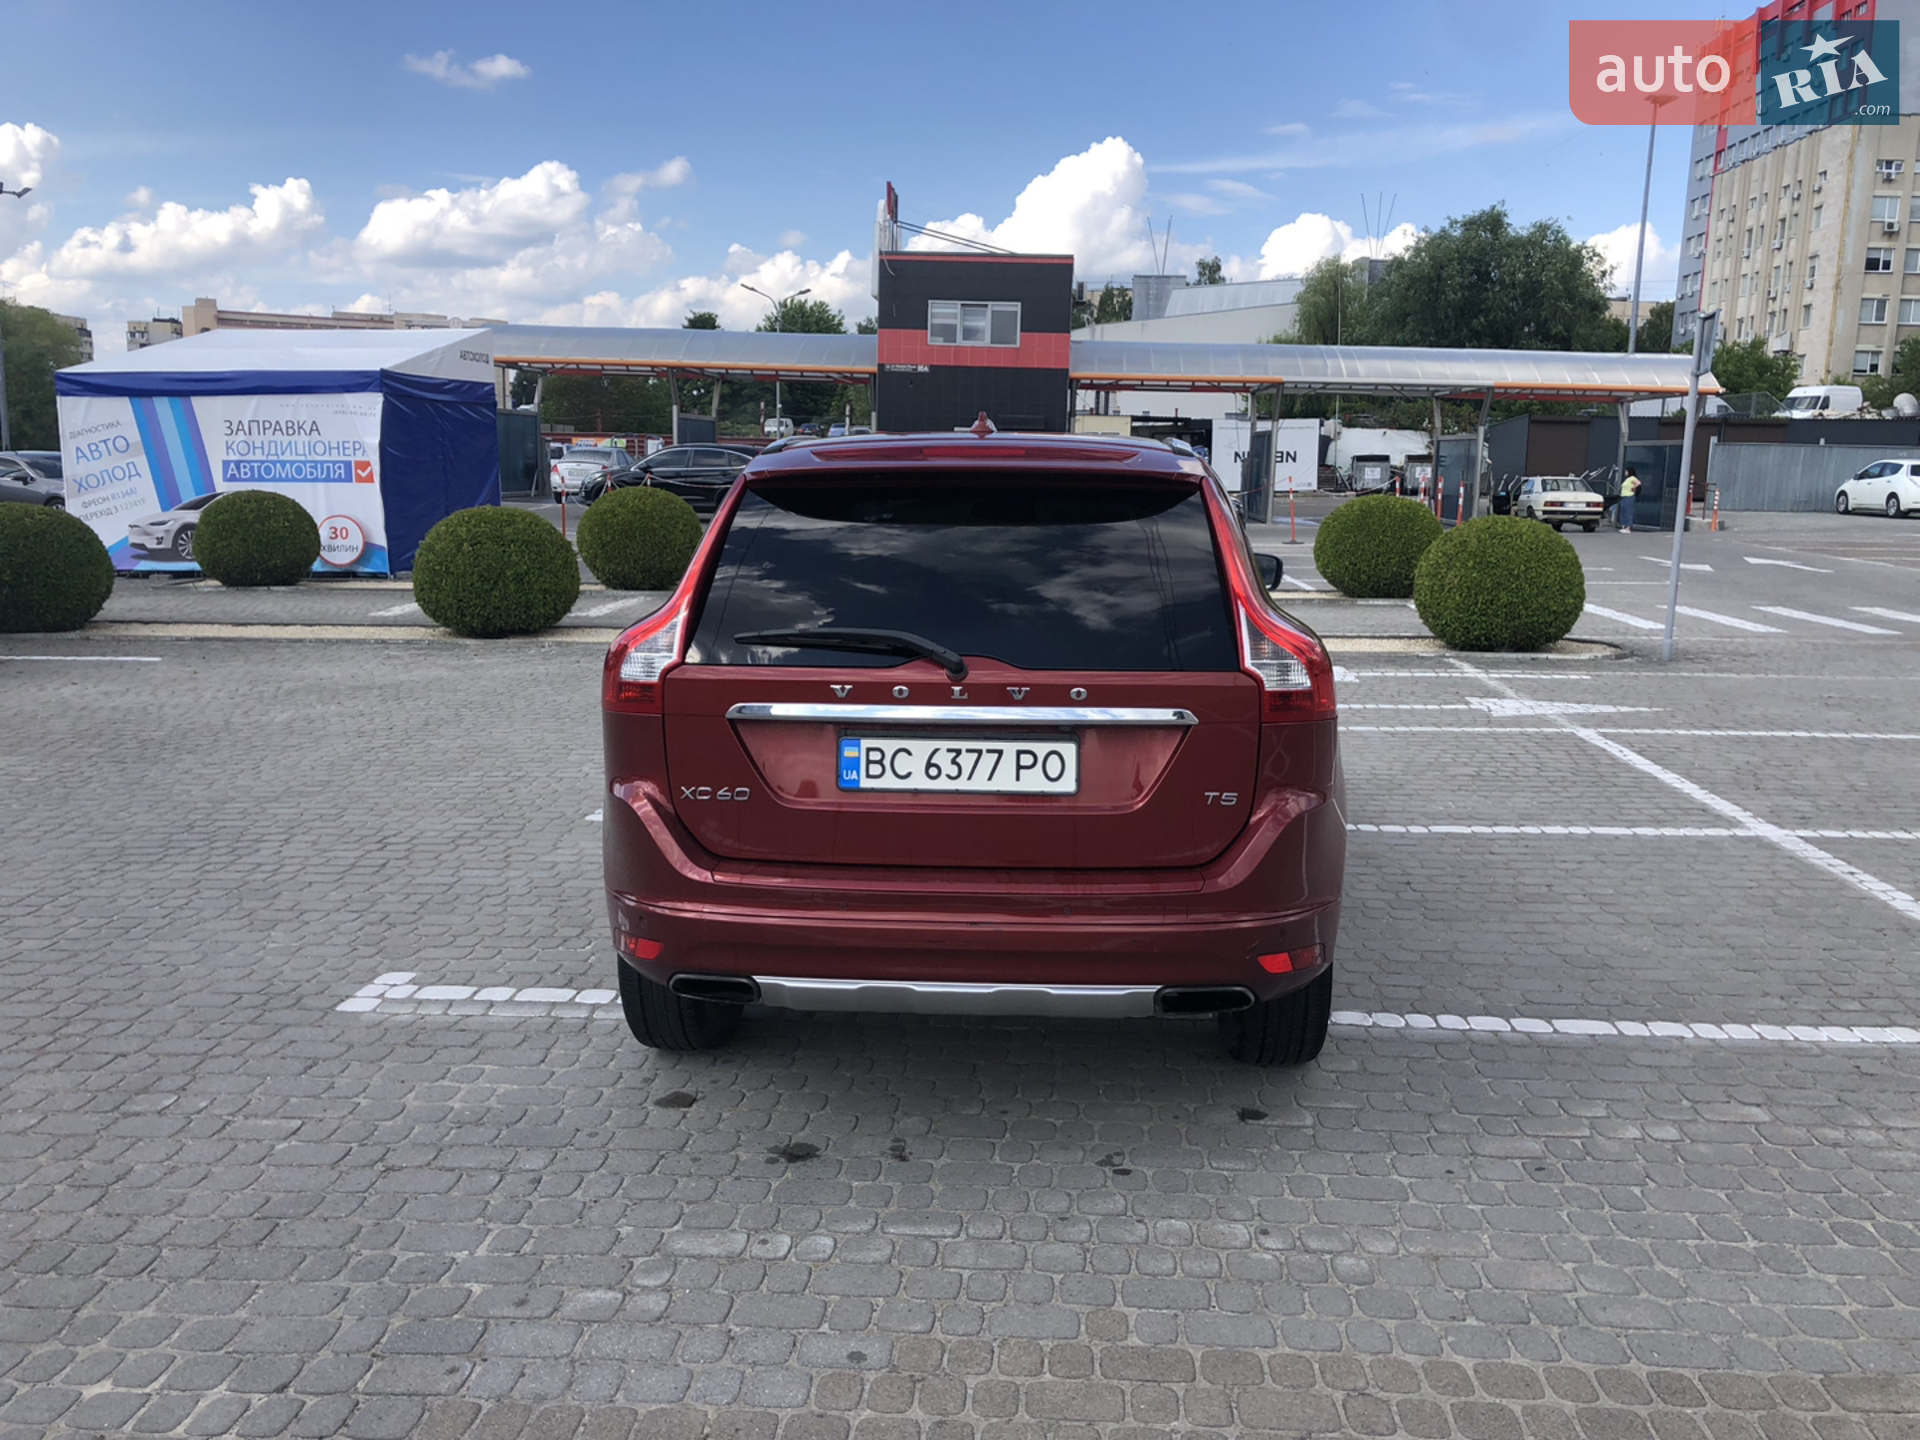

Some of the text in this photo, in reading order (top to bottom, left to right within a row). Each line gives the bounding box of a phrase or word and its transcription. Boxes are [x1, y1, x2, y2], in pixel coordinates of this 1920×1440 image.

[68, 420, 122, 440] ДІАГНОСТИКА
[223, 419, 321, 437] ЗАПРАВКА
[75, 435, 130, 465] АВТО
[72, 461, 142, 493] ХОЛОД
[226, 462, 345, 479] АВТОМОБІЛЯ
[81, 494, 111, 509] ФРЕОН
[329, 526, 349, 540] 30
[829, 684, 1088, 702] VOLVO
[864, 746, 1067, 783] BC 6377 PO
[843, 770, 859, 781] UA
[1204, 791, 1239, 806] T5
